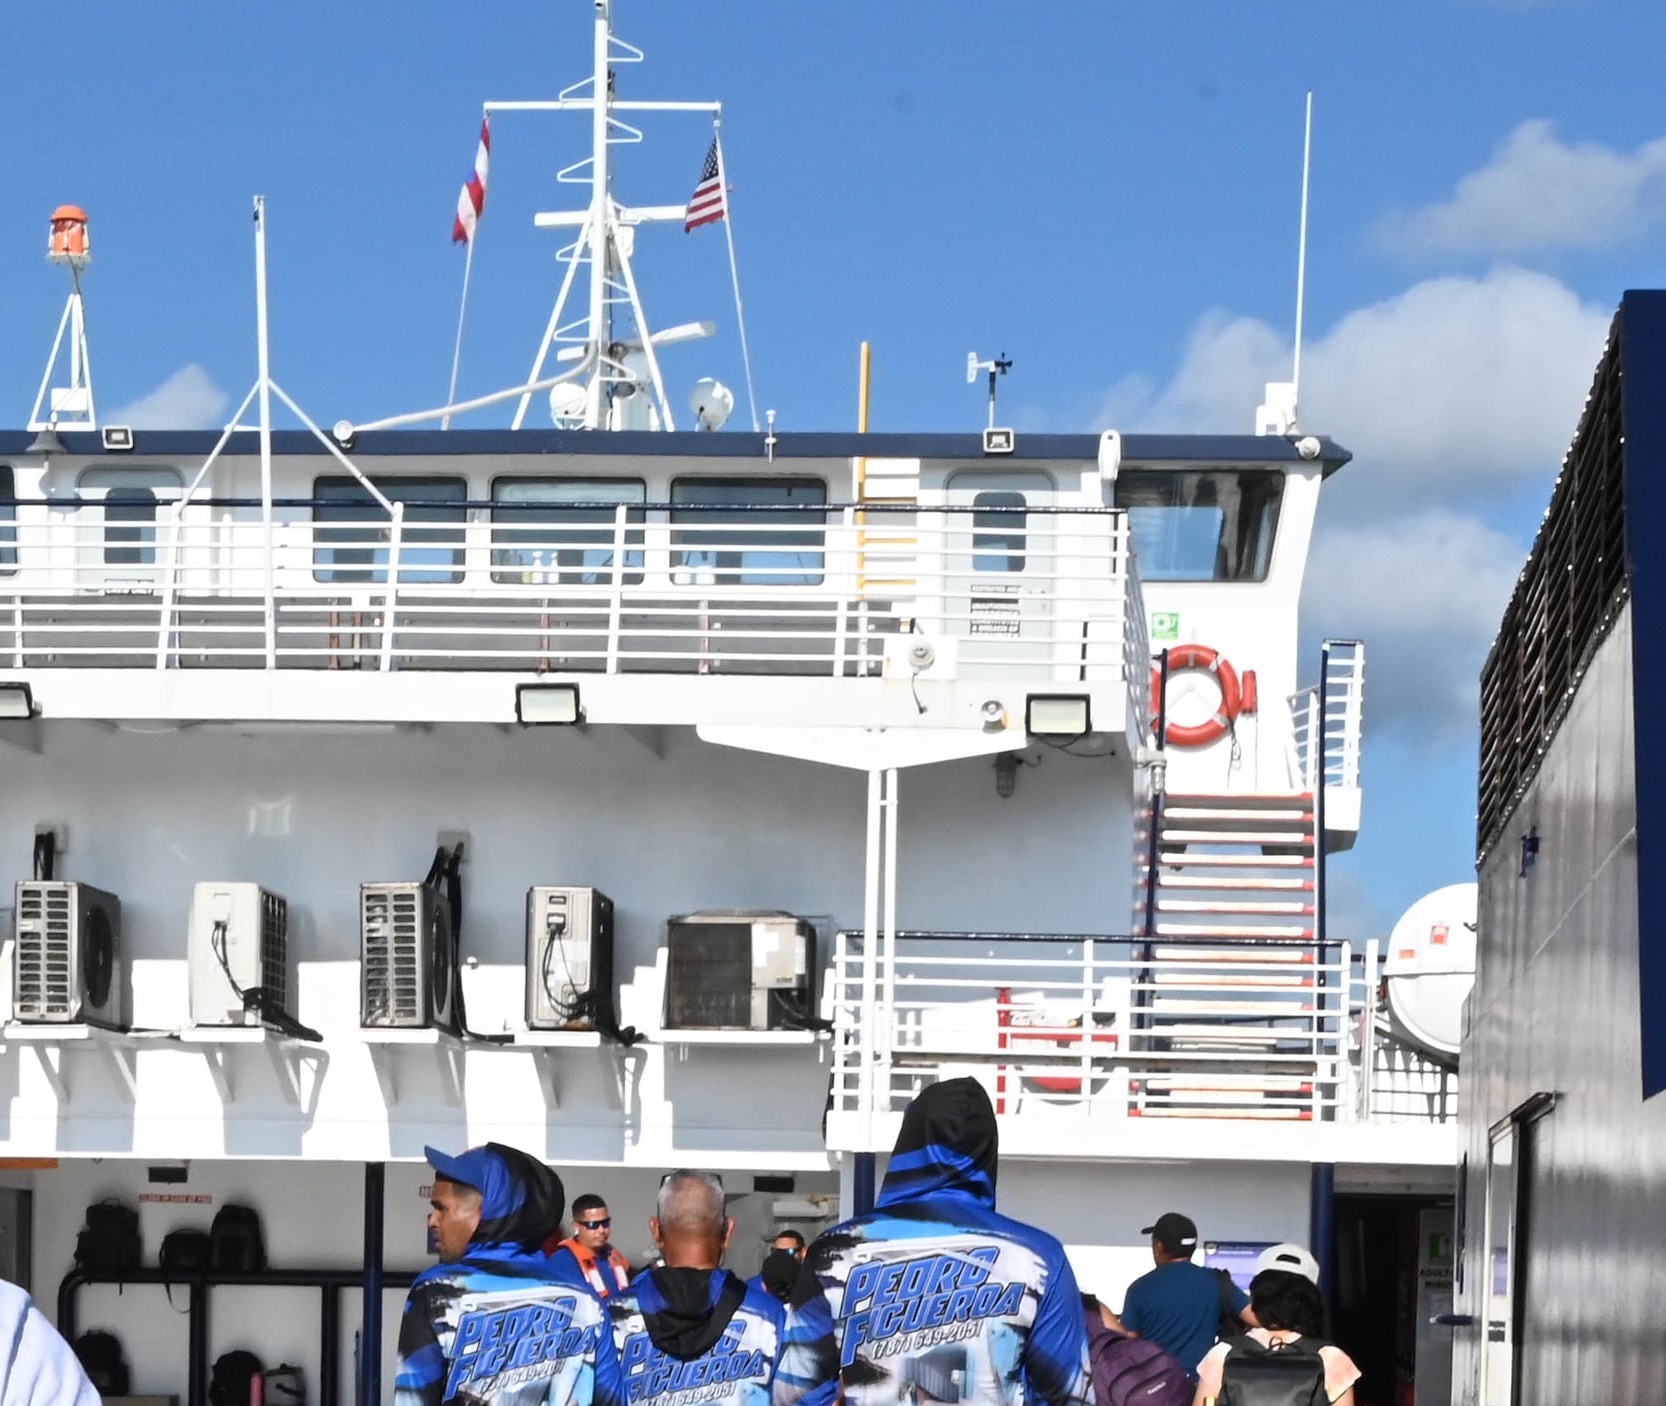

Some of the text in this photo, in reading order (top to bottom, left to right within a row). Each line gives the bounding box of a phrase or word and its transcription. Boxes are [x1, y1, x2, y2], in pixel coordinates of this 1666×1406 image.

[840, 1246, 1001, 1319] PEDRO
[451, 1296, 578, 1359] PEDRO
[621, 1319, 747, 1378] PEO
[840, 1282, 1026, 1368] FIGUEROA
[872, 1321, 983, 1359] (787) 649-2051
[442, 1325, 599, 1404] FIGUEROA
[623, 1349, 766, 1403] FIGUEROA
